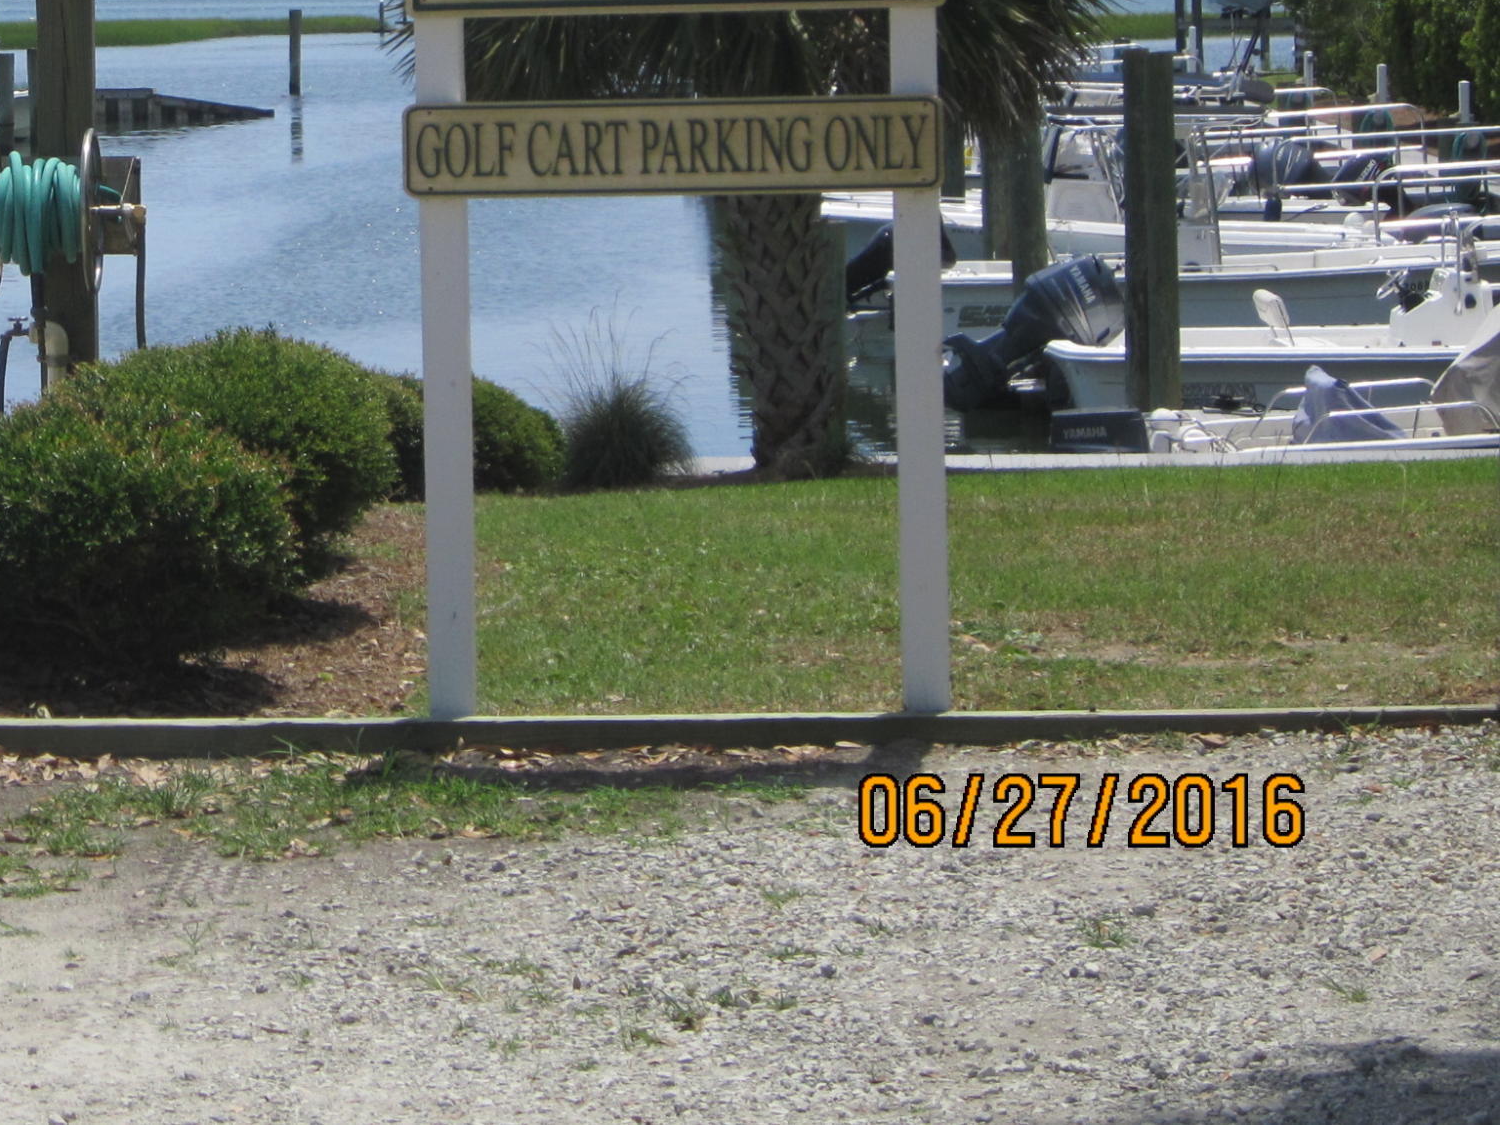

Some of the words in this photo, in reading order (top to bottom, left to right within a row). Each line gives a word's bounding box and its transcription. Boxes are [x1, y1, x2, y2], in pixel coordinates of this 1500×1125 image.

[416, 121, 516, 178] GOLF
[526, 120, 629, 176] CART
[638, 115, 813, 175] PARKING
[824, 114, 930, 171] ONLY
[1070, 265, 1096, 304] YAMAHA
[1063, 426, 1108, 439] YAMAHA
